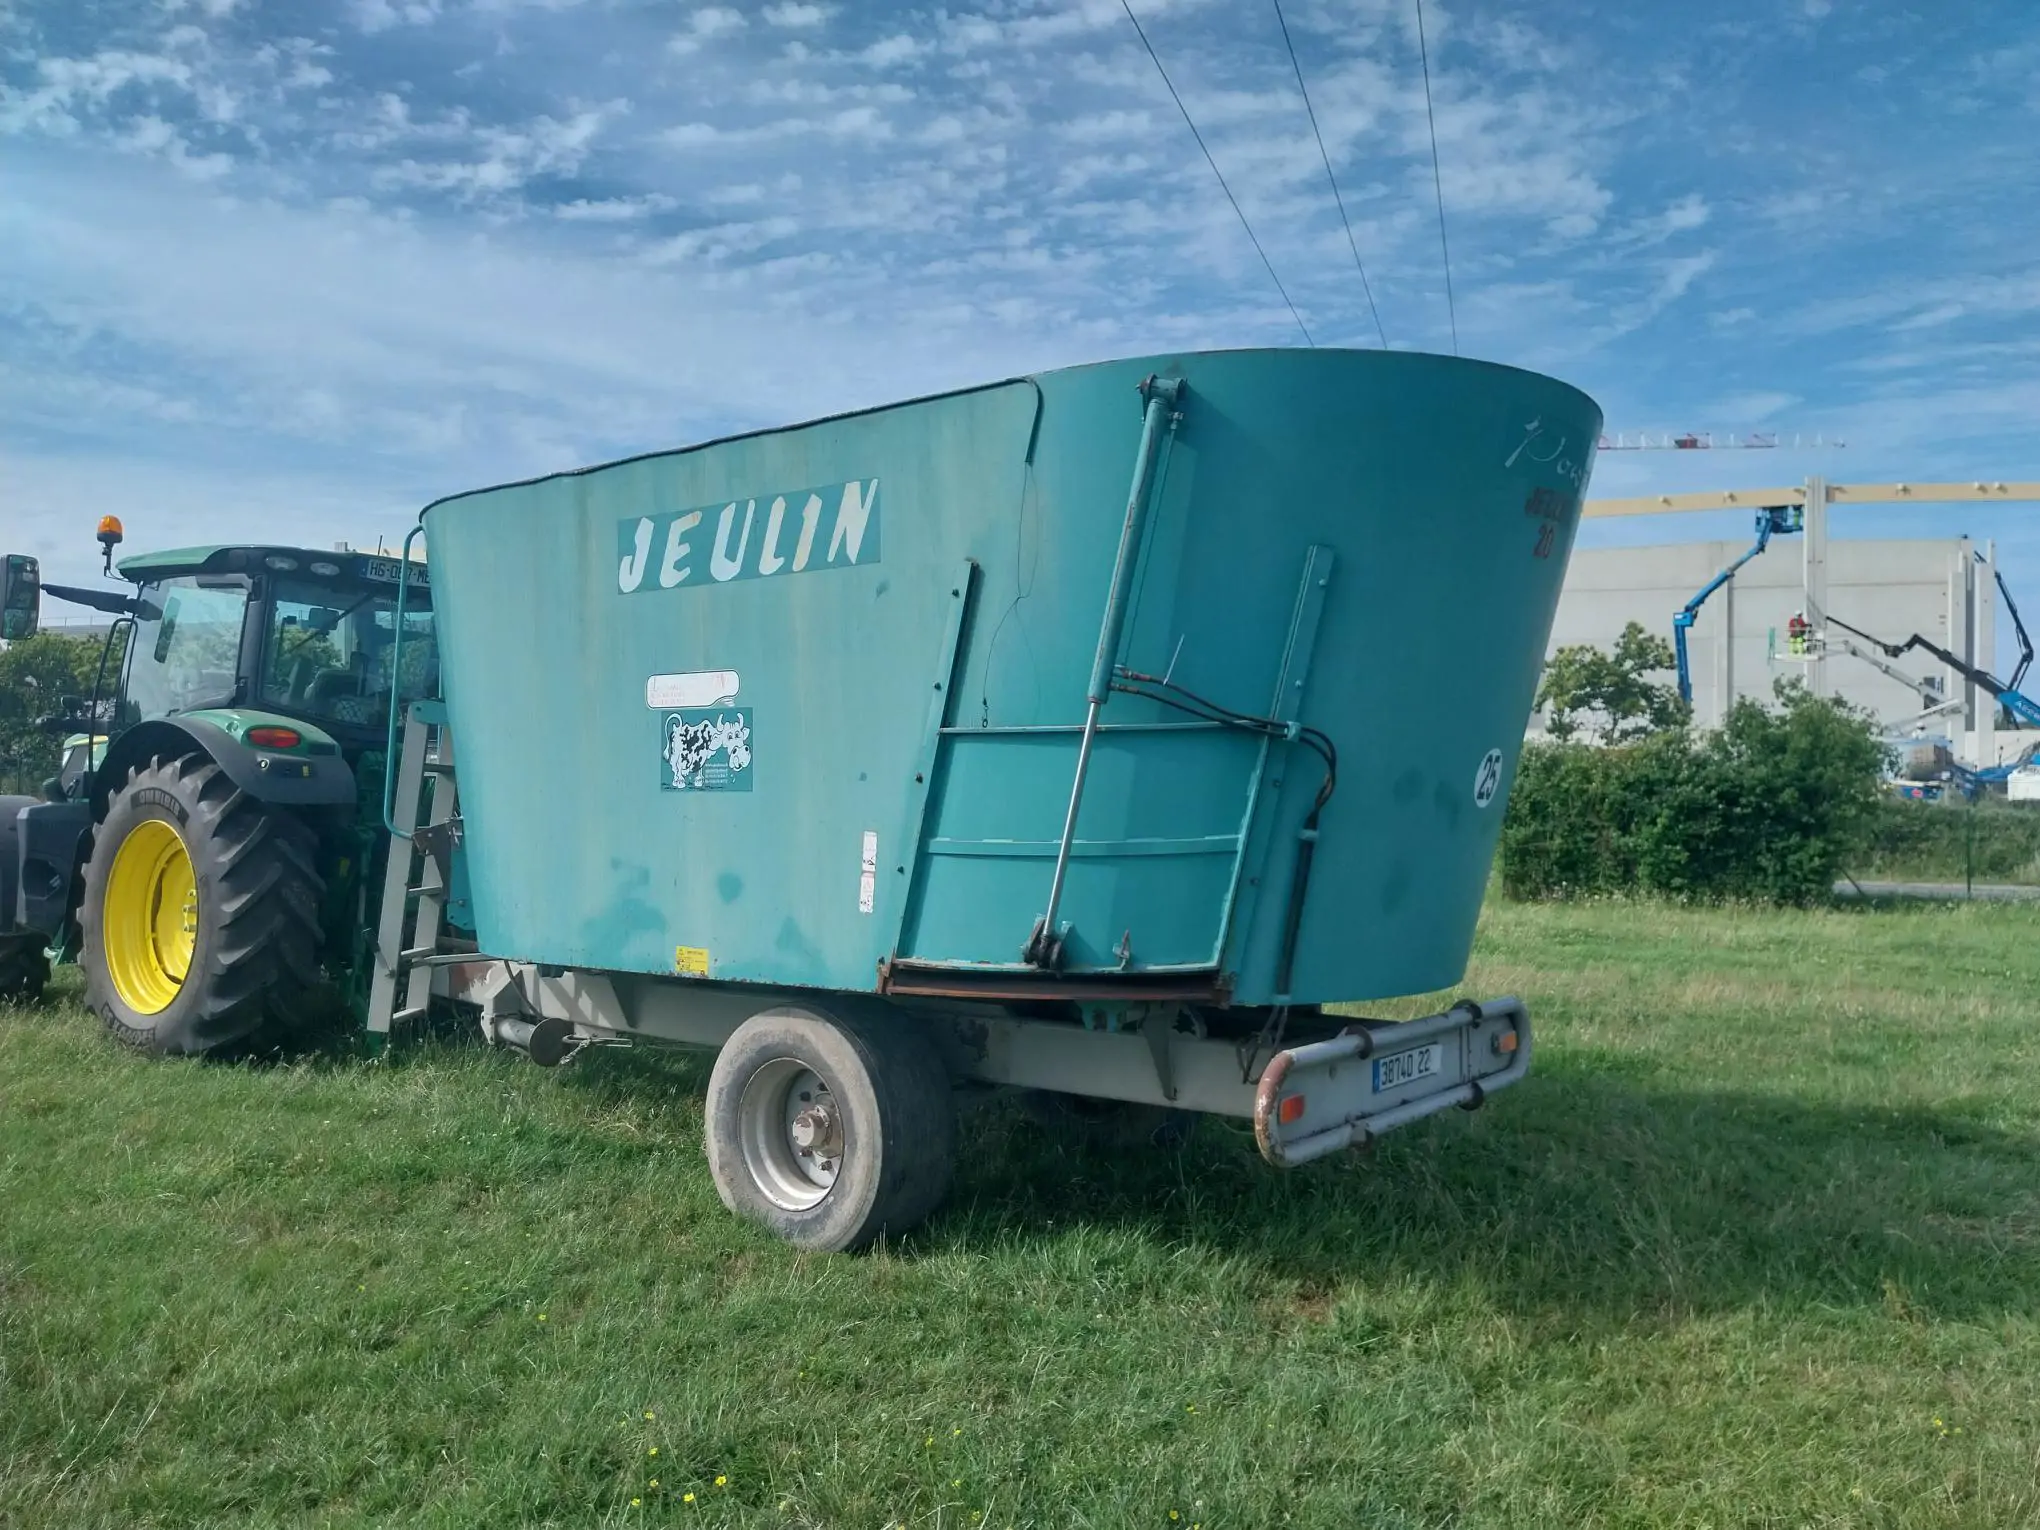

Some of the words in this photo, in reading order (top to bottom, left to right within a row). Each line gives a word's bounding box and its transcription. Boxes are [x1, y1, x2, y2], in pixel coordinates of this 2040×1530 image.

[619, 478, 878, 593] JEULIN
[1533, 522, 1555, 560] 20
[1476, 753, 1501, 800] 25
[1418, 1048, 1431, 1074] 22
